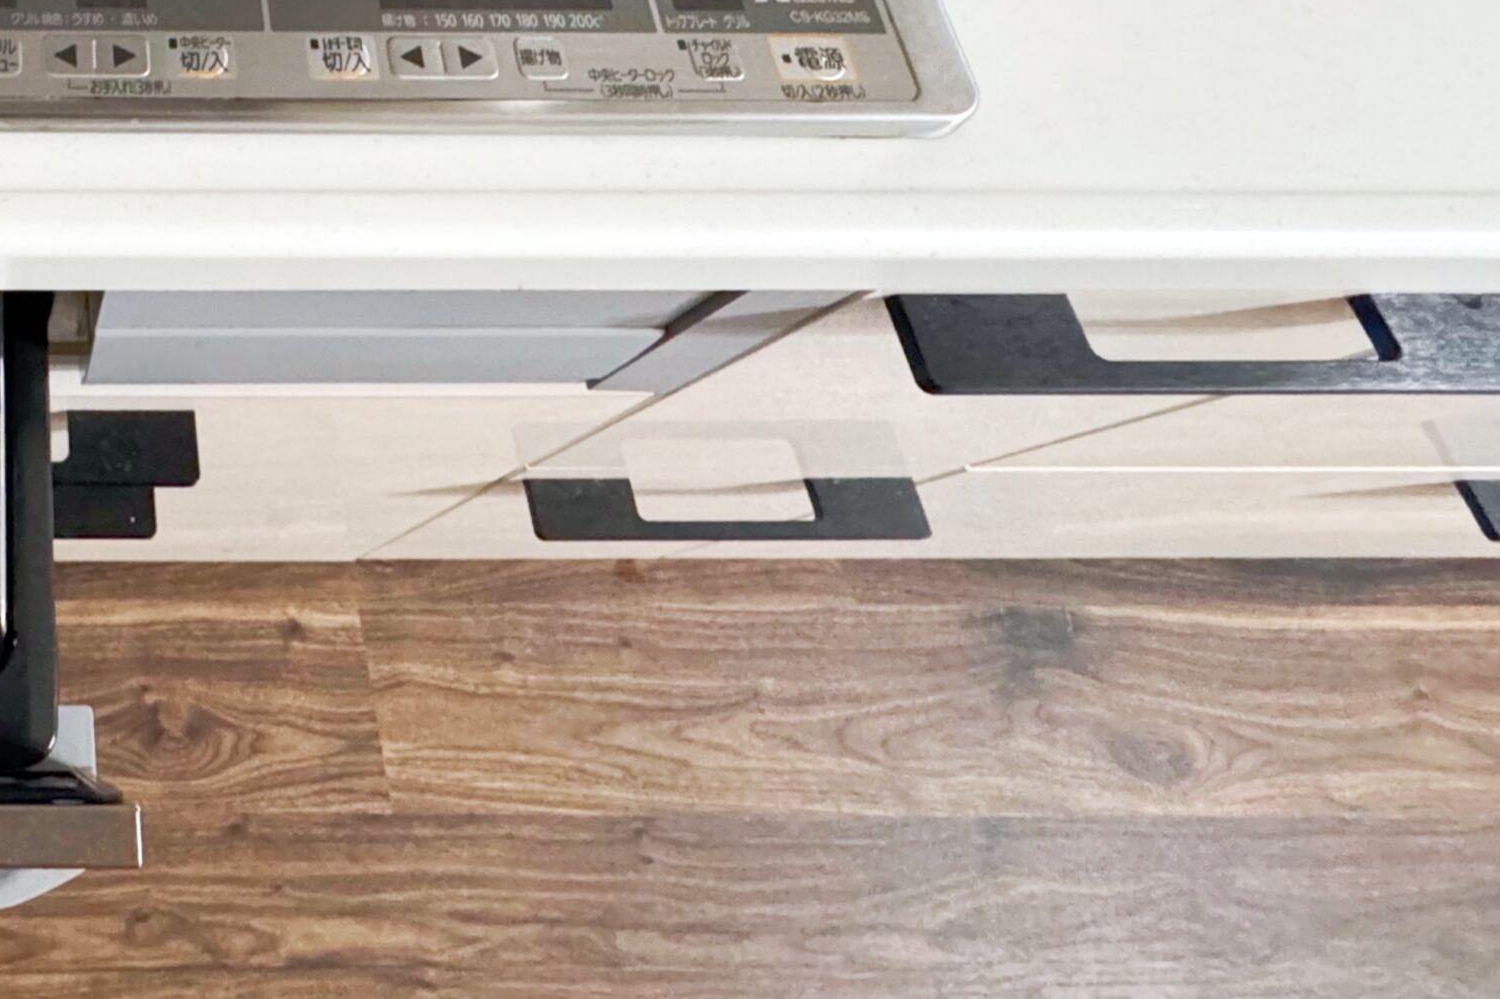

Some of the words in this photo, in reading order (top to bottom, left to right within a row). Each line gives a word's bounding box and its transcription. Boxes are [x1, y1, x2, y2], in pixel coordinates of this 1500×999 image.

[435, 13, 457, 28] 150
[461, 13, 484, 28] 160
[489, 13, 511, 28] 170
[516, 13, 539, 28] 180
[542, 13, 566, 28] 190
[180, 51, 229, 73] 切/入
[322, 52, 372, 73] 切/入
[794, 47, 848, 71] 電源
